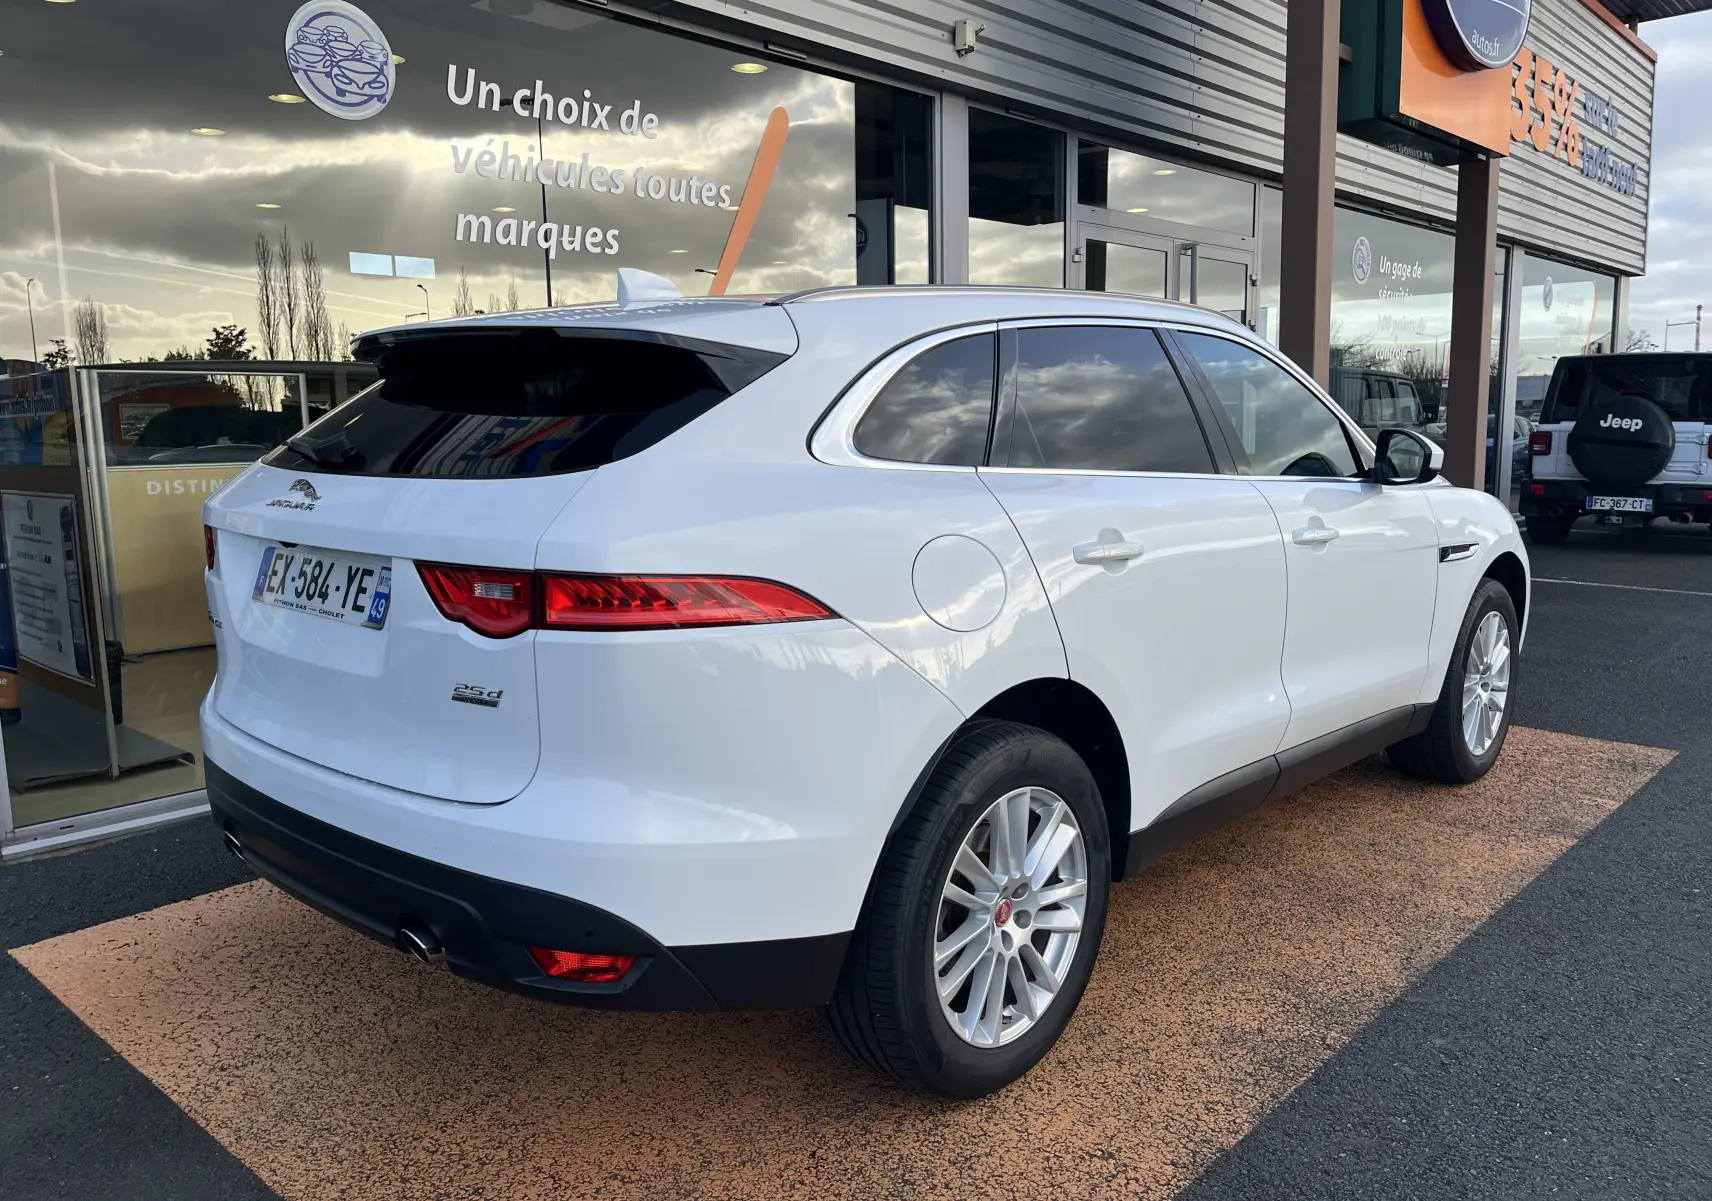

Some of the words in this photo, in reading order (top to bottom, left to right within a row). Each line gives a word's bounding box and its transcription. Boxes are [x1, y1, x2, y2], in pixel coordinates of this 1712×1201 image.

[1471, 29, 1501, 57] autos.fr
[447, 64, 502, 112] Un
[513, 80, 613, 132] choix
[619, 100, 660, 140] de
[1510, 46, 1580, 167] 35%
[1584, 91, 1606, 127] sur
[1607, 95, 1619, 138] le
[1580, 135, 1611, 184] tarif
[451, 138, 626, 195] véhicules
[633, 166, 732, 209] toutes
[456, 212, 620, 260] marques
[1380, 255, 1391, 275] Un
[1391, 262, 1412, 281] gage
[1412, 261, 1422, 279] de
[1600, 413, 1643, 432] Jeep
[147, 479, 228, 495] DISTIN
[266, 499, 316, 512] JAGUAR
[1593, 497, 1645, 510] FC-367-CT
[273, 598, 295, 608] PITHON
[295, 602, 307, 611] SAS
[318, 608, 345, 620] CHOLET
[370, 597, 386, 619] 49
[453, 683, 504, 699] 25d
